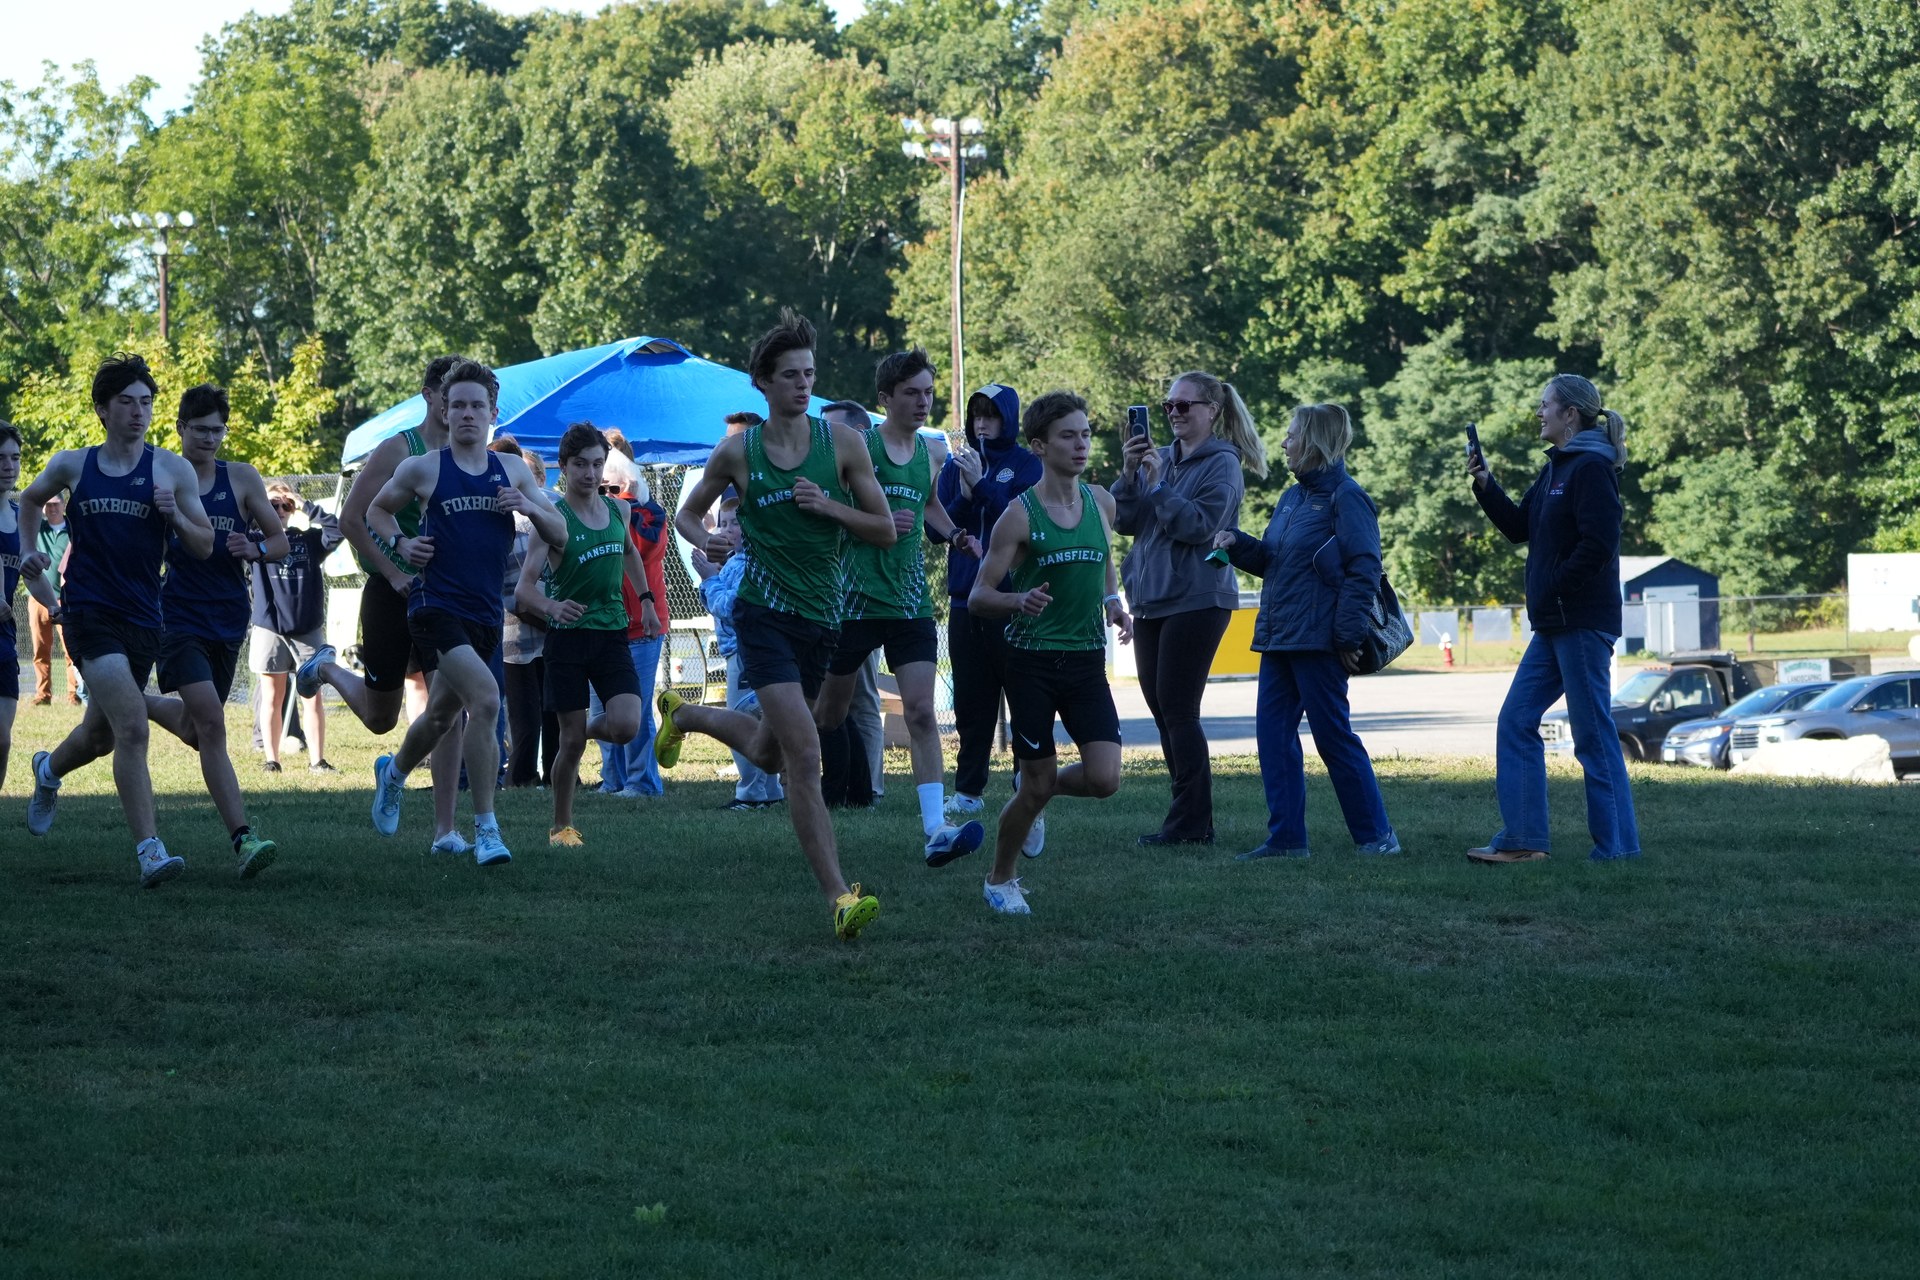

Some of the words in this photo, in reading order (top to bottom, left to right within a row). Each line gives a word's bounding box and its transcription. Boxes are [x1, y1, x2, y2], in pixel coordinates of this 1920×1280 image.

[884, 485, 923, 502] NSFIELD
[79, 497, 152, 520] FOXBORO
[578, 543, 624, 564] MANSFIEL
[1036, 550, 1104, 567] MANSFIELD
